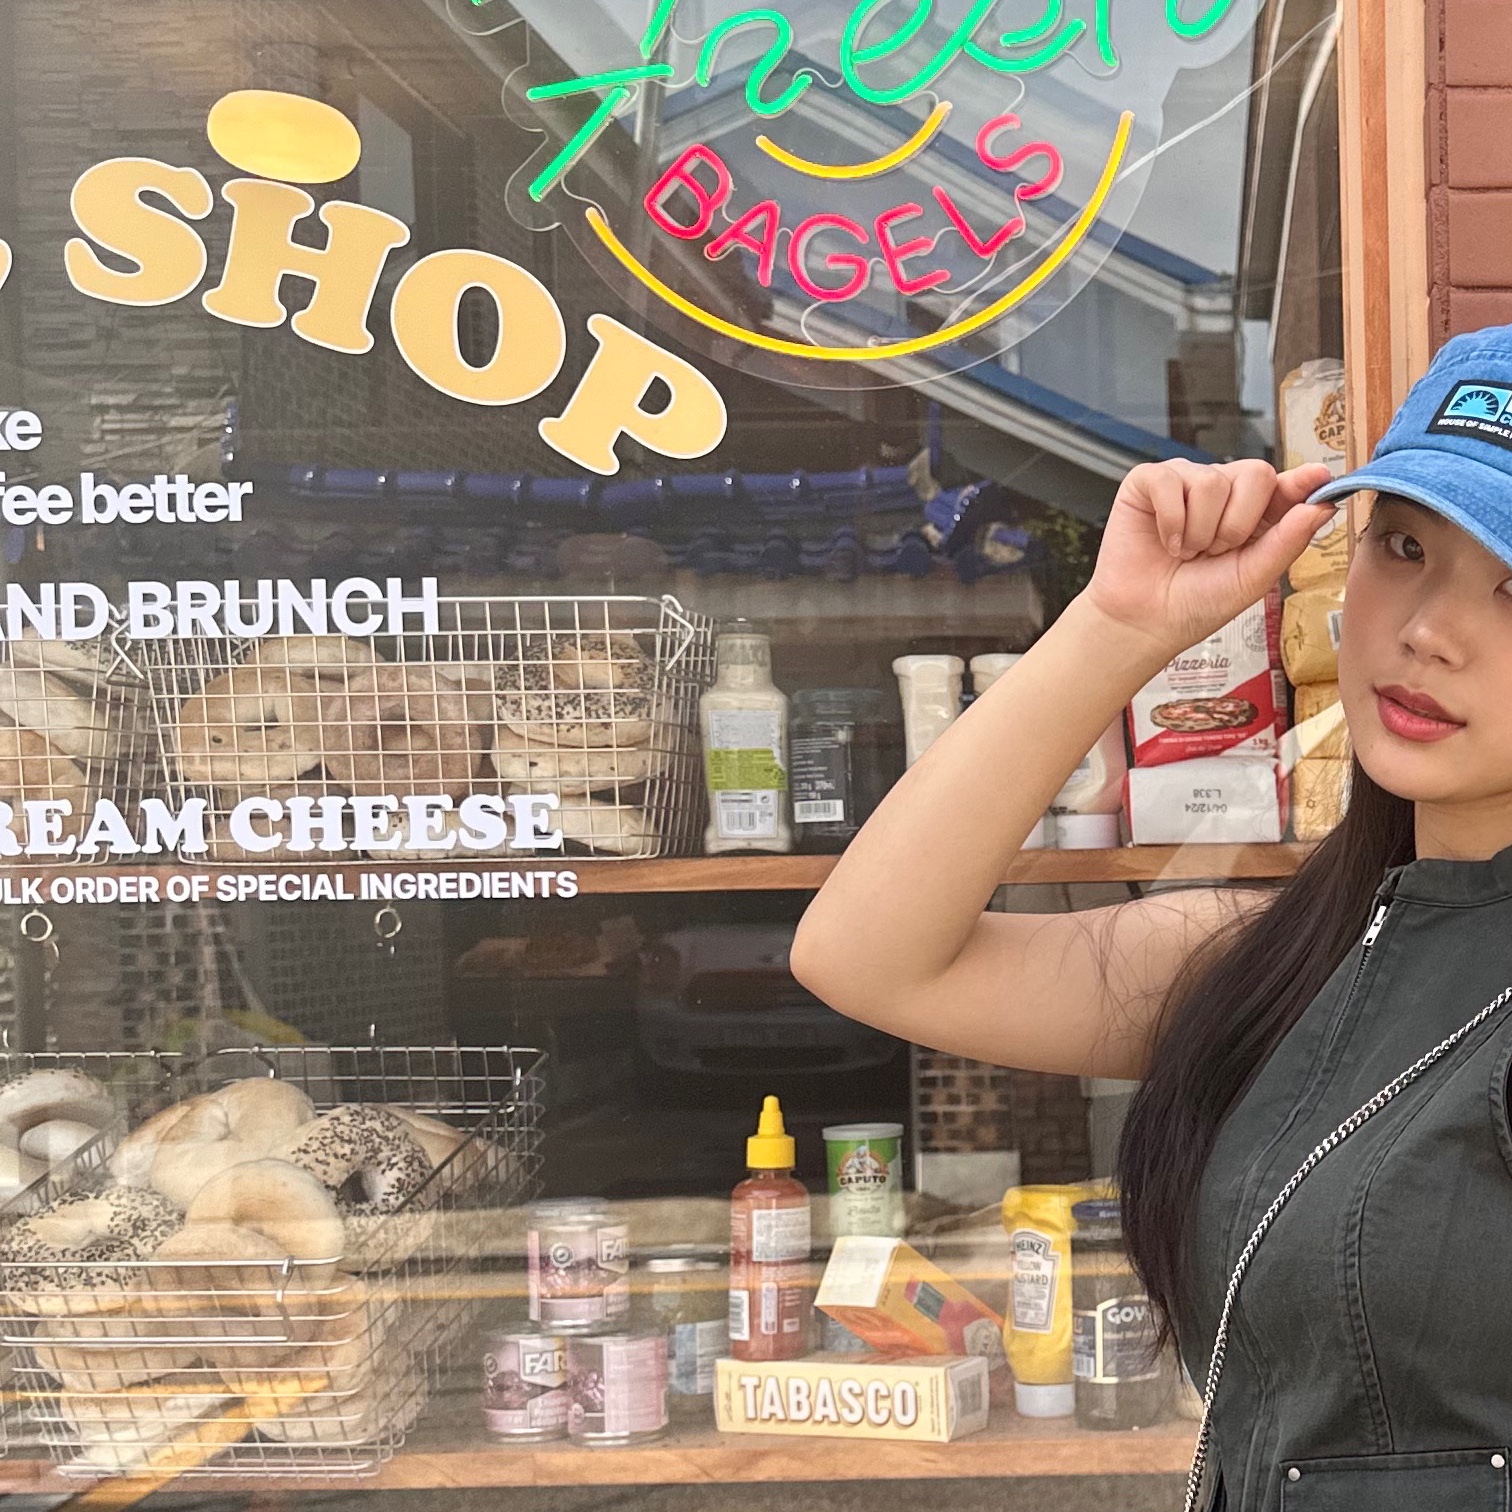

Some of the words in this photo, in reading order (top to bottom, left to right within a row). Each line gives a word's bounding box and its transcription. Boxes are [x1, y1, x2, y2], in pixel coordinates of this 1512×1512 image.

[644, 114, 1063, 301] BAGELS
[64, 156, 728, 476] SHOP
[1319, 425, 1345, 441] CAP
[1437, 418, 1467, 427] HOUSE
[1466, 420, 1479, 428] OF
[1478, 422, 1511, 438] SIMPLE
[0, 471, 74, 525] ee
[80, 472, 254, 524] better
[0, 580, 110, 642] ND
[128, 577, 439, 639] BRUNCH
[229, 793, 564, 853] CHEESE
[0, 876, 45, 905] LK
[50, 875, 160, 904] ORDER
[166, 874, 209, 903] OF
[215, 872, 356, 902] SPECIAL
[360, 870, 578, 900] INGREDIENTS
[840, 1175, 886, 1186] CAPUTO
[1107, 1306, 1148, 1325] GOY
[523, 1351, 568, 1376] FAR
[739, 1375, 919, 1428] TABASCO
